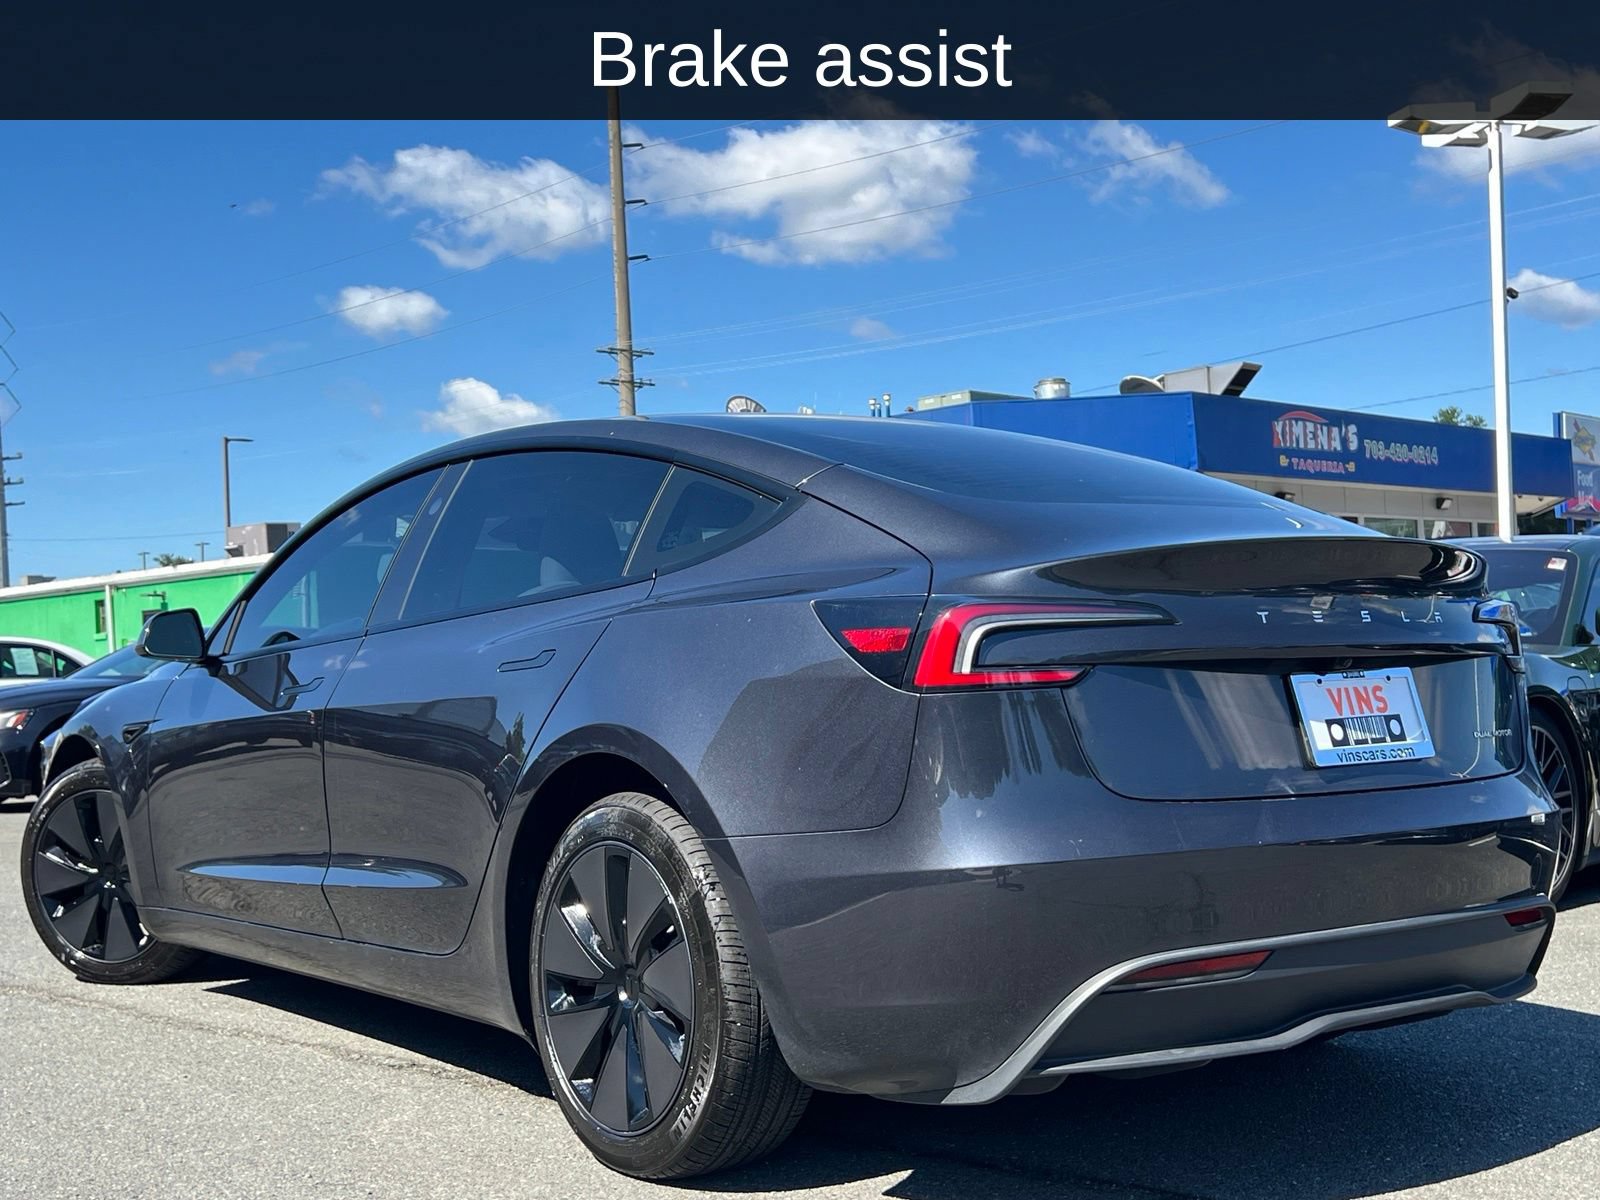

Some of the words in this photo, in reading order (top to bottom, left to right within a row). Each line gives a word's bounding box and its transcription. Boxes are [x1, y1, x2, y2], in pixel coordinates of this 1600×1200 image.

[1272, 420, 1359, 452] XIMENA'S
[1364, 439, 1438, 466] 703-420-0214
[1291, 457, 1345, 474] TAQUERIA
[1256, 610, 1443, 624] TESLA
[1325, 684, 1389, 716] VINS
[1336, 746, 1416, 763] vinscars.com
